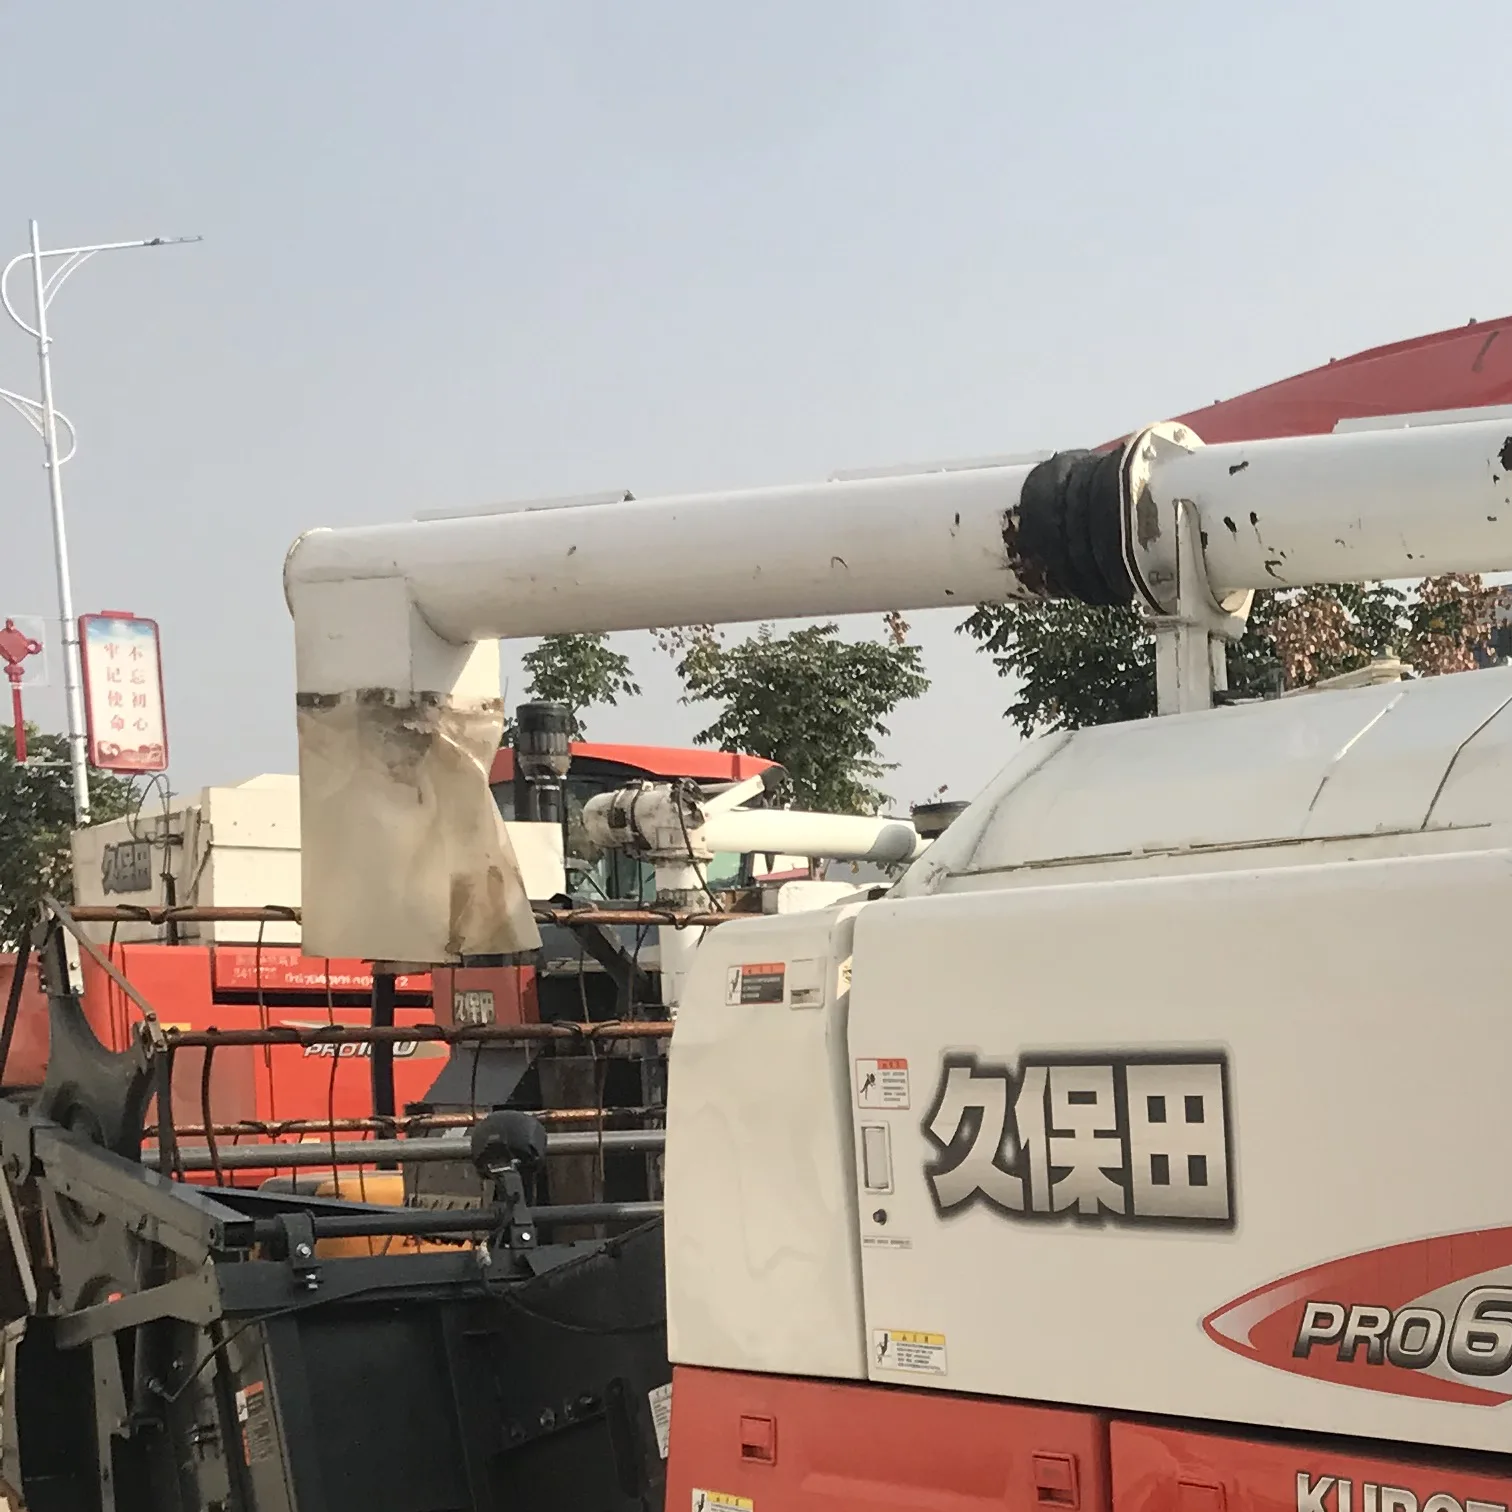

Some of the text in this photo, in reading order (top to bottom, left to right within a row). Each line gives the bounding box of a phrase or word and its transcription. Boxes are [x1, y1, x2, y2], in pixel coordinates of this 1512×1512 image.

[104, 643, 126, 732] 牢记使命
[129, 644, 149, 732] 不忘初心
[927, 1060, 1231, 1221] 久保田
